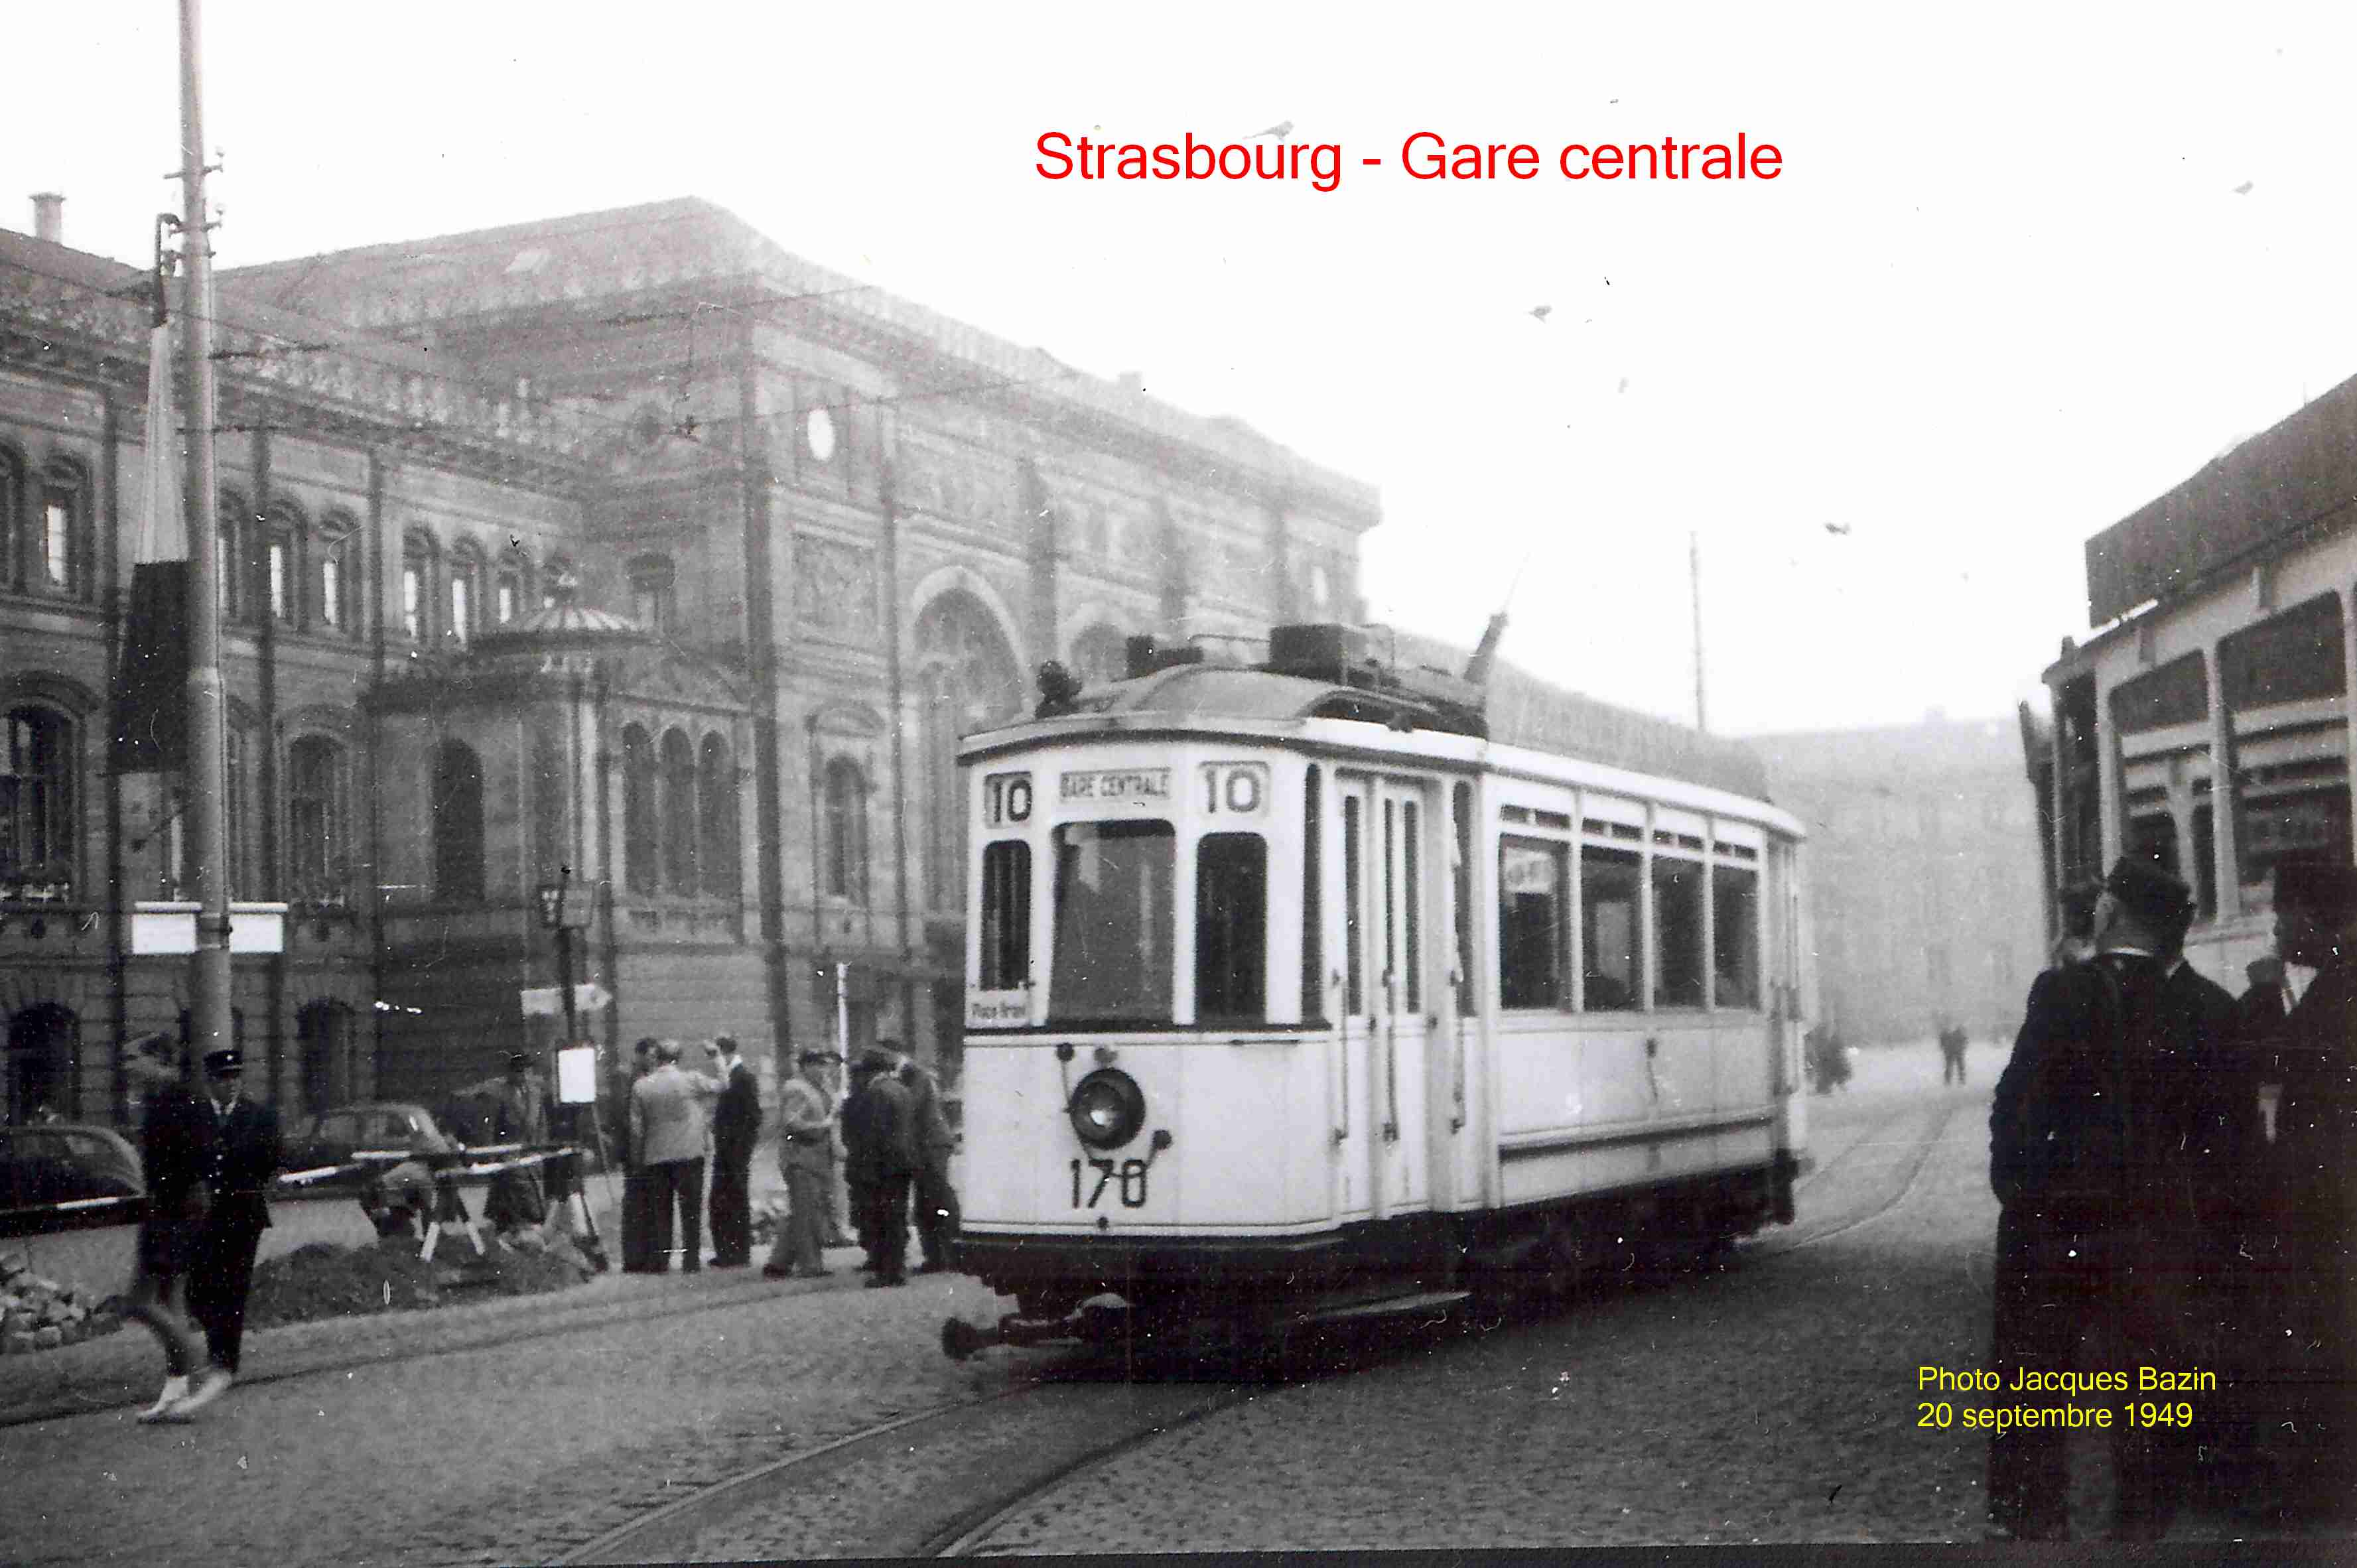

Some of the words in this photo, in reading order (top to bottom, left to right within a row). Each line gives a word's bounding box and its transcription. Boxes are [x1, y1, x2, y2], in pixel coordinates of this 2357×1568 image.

[994, 779, 1032, 823] 10
[1061, 773, 1093, 797] GARE
[1100, 772, 1169, 797] CENTRALE
[1205, 767, 1261, 814] 10
